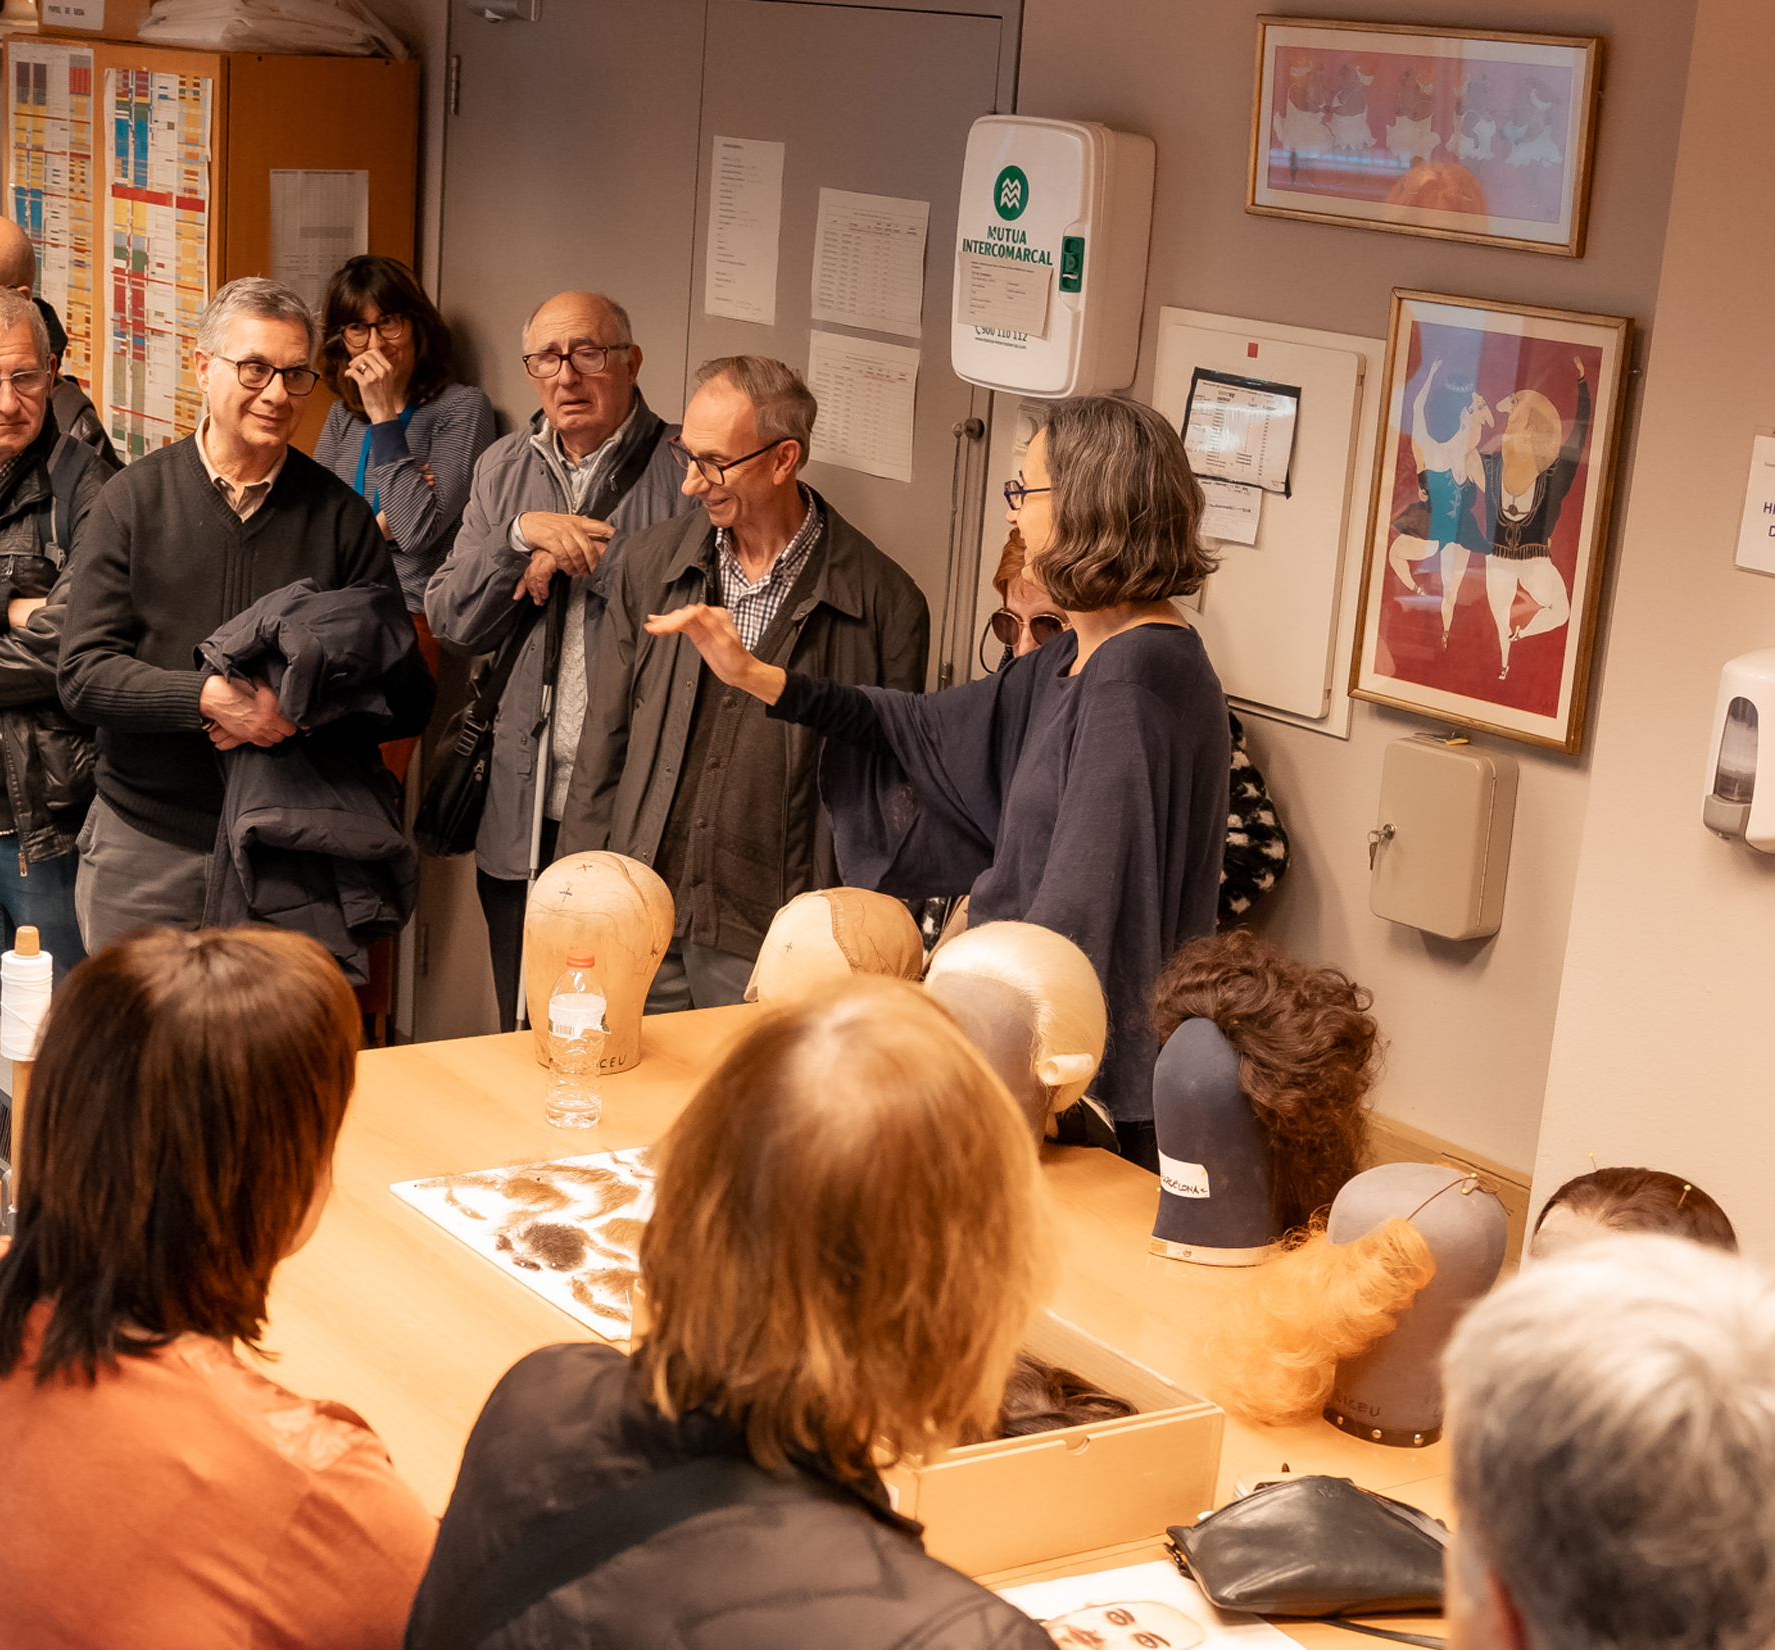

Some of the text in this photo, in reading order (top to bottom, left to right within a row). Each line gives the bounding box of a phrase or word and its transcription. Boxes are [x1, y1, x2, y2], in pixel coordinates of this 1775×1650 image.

[987, 225, 1027, 245] MUTUA
[962, 238, 1053, 266] INTERCOMARCAL
[997, 328, 1011, 339] 110
[596, 1054, 628, 1069] CEU
